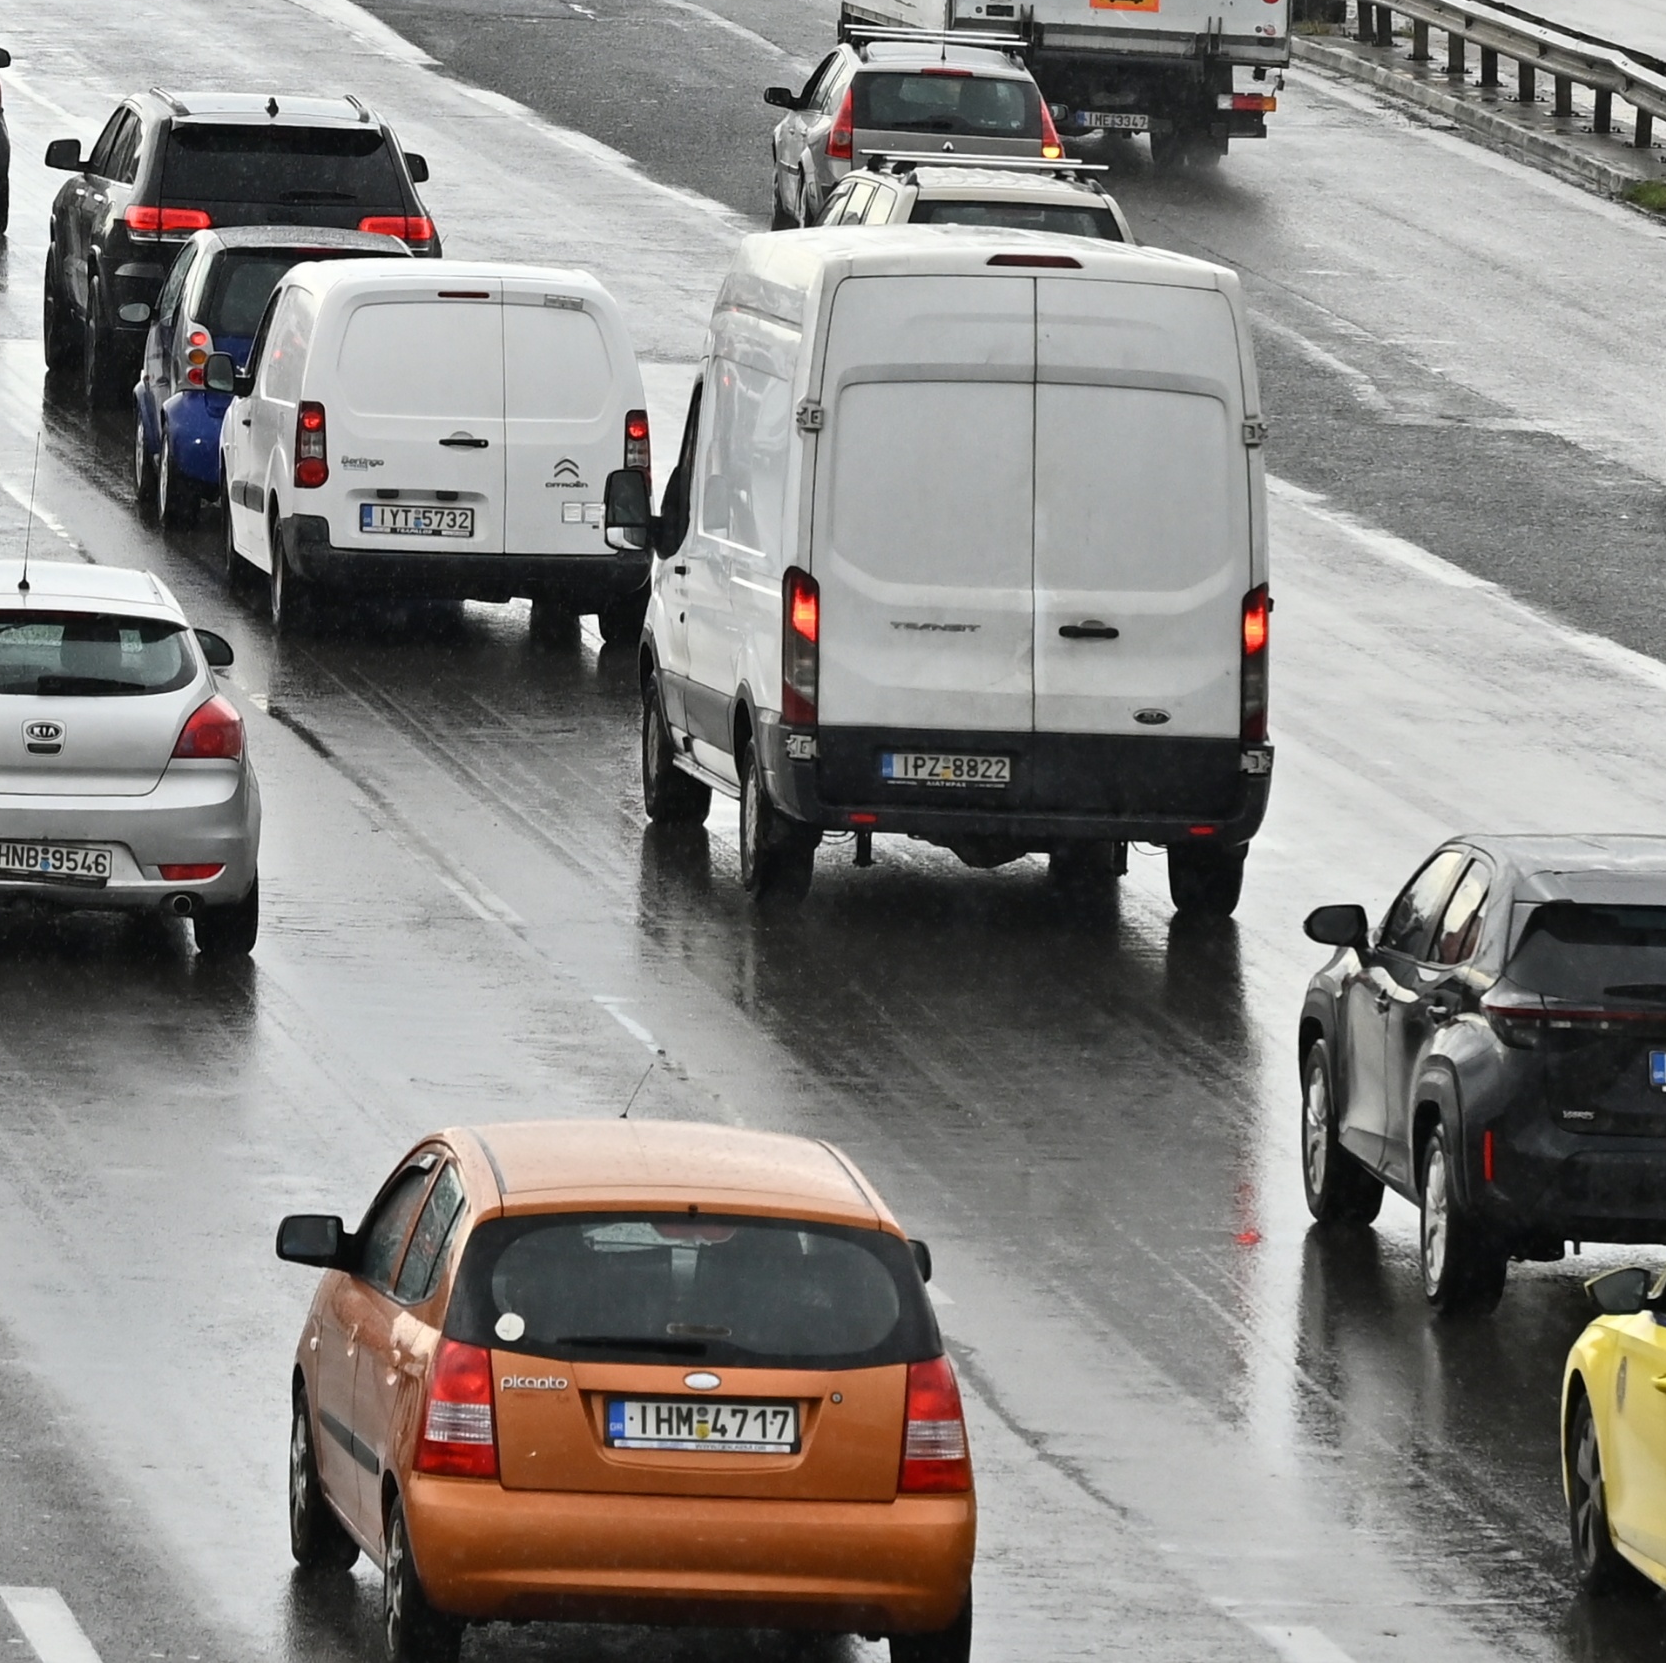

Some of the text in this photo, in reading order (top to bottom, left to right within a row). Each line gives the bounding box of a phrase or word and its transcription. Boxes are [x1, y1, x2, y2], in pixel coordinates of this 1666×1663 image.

[890, 621, 982, 633] TRANSIT
[33, 726, 56, 737] KIA
[900, 755, 1008, 780] IPZ-8822
[501, 1374, 568, 1393] picanto
